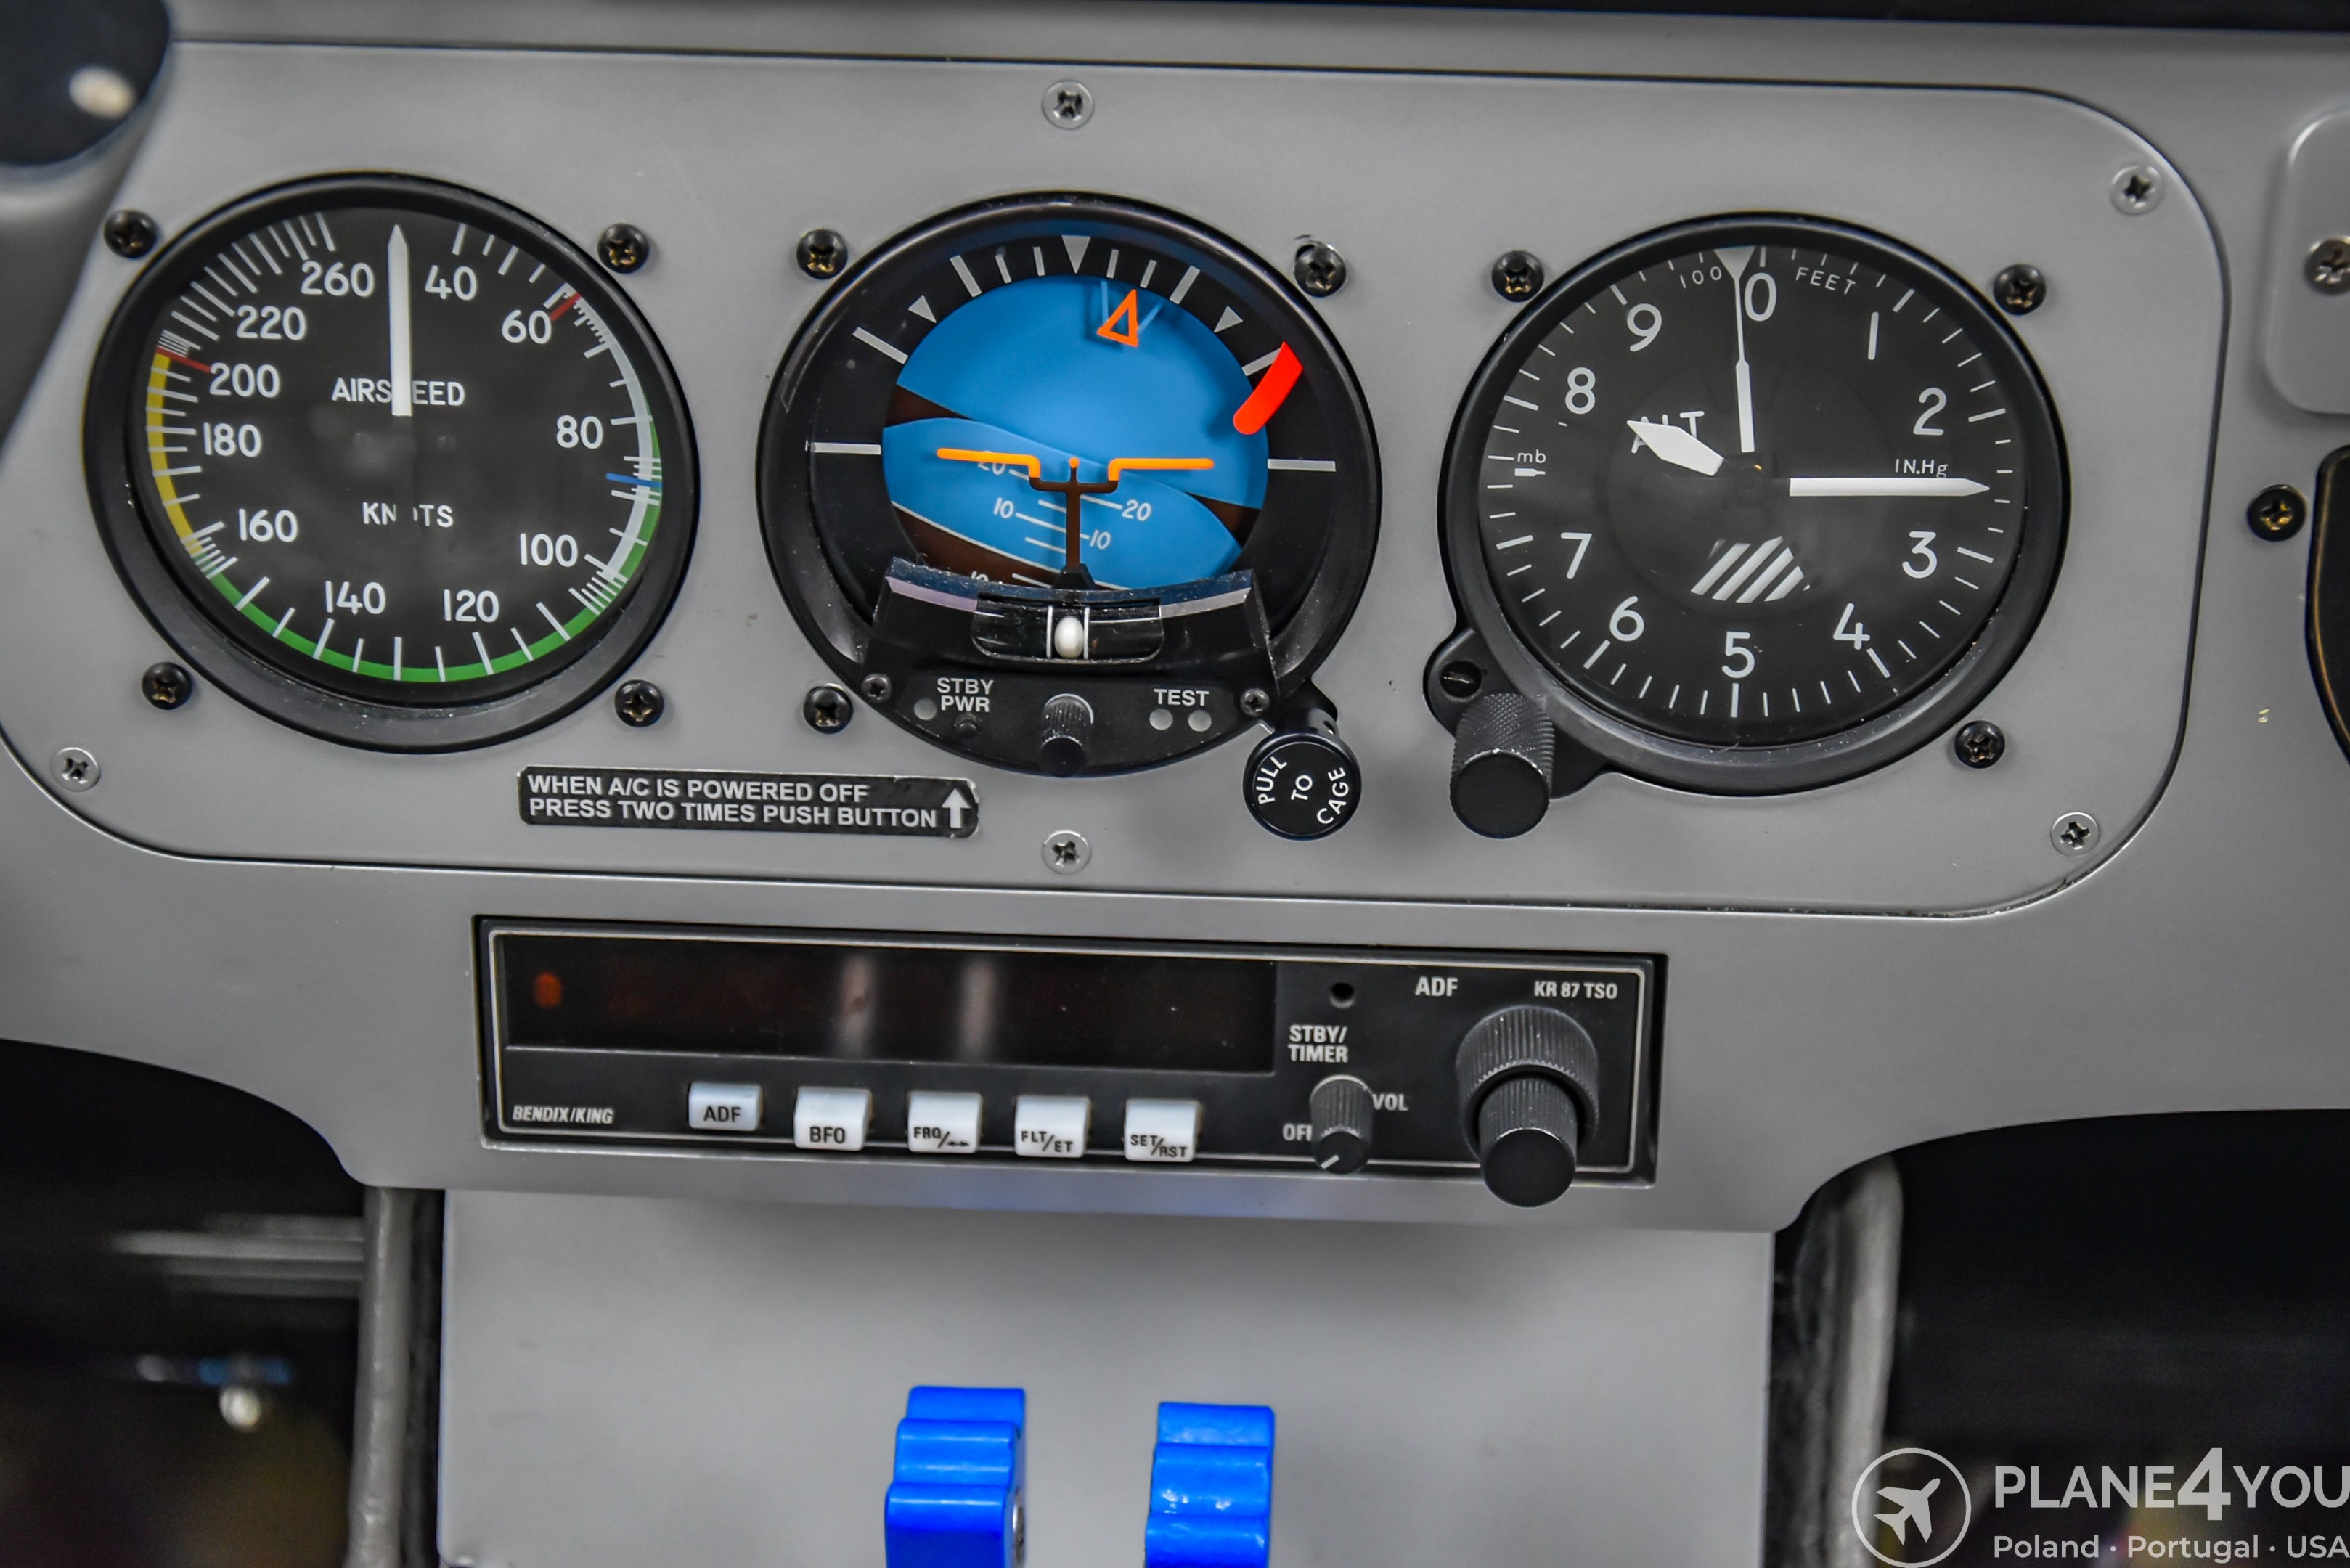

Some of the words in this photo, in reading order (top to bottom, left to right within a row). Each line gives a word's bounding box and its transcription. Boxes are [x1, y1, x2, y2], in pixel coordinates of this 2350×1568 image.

[301, 261, 375, 298] 260
[425, 265, 478, 301] 40
[1679, 266, 1722, 289] 100
[1795, 266, 1856, 295] FEET
[1744, 272, 1777, 322] 0
[237, 305, 307, 340] 220
[499, 306, 550, 346] 60
[1626, 303, 1662, 352] 9
[208, 361, 280, 399] 200
[331, 377, 465, 406] AIRSEED
[1564, 367, 1596, 415] 8
[1913, 387, 1946, 436] 2
[203, 422, 262, 457] 180
[556, 415, 603, 449] 80
[1517, 449, 1546, 464] mb
[362, 502, 454, 528] KNTS
[993, 497, 1014, 519] 10
[1122, 499, 1152, 522] 20
[238, 508, 298, 543] 160
[1090, 529, 1111, 550] 10
[520, 533, 579, 568] 100
[1560, 532, 1593, 579] 7
[1902, 531, 1938, 579] 3
[325, 580, 386, 615] 140
[444, 589, 499, 623] 120
[1609, 595, 1645, 642] 6
[1832, 603, 1871, 650] 4
[1721, 631, 1755, 679] 5
[937, 677, 995, 697] STBY
[940, 695, 990, 713] PWR
[1153, 687, 1211, 707] TEST
[527, 775, 603, 795] WHEN
[608, 778, 650, 796] A/C
[656, 779, 680, 798] IS
[688, 780, 813, 801] POWERED
[819, 783, 869, 803] OFF
[1255, 756, 1288, 804] PULL
[1290, 775, 1313, 801] TO
[1316, 767, 1350, 825] CAGE
[529, 798, 611, 818] PRESS
[617, 800, 674, 820] TWO
[680, 802, 756, 823] TIMES
[763, 804, 830, 825] PUSH
[837, 807, 937, 828] BUTTON
[1415, 976, 1458, 997] ADF
[1533, 980, 1559, 998] KR
[1561, 981, 1580, 999] 87
[1583, 982, 1618, 1000] TSO
[1289, 1024, 1348, 1043] STBY/
[1287, 1043, 1349, 1063] TIMER
[513, 1105, 613, 1124] BENDIX/KING
[703, 1106, 741, 1123] ADF
[1371, 1093, 1408, 1111] VOL
[809, 1126, 846, 1144] BFO
